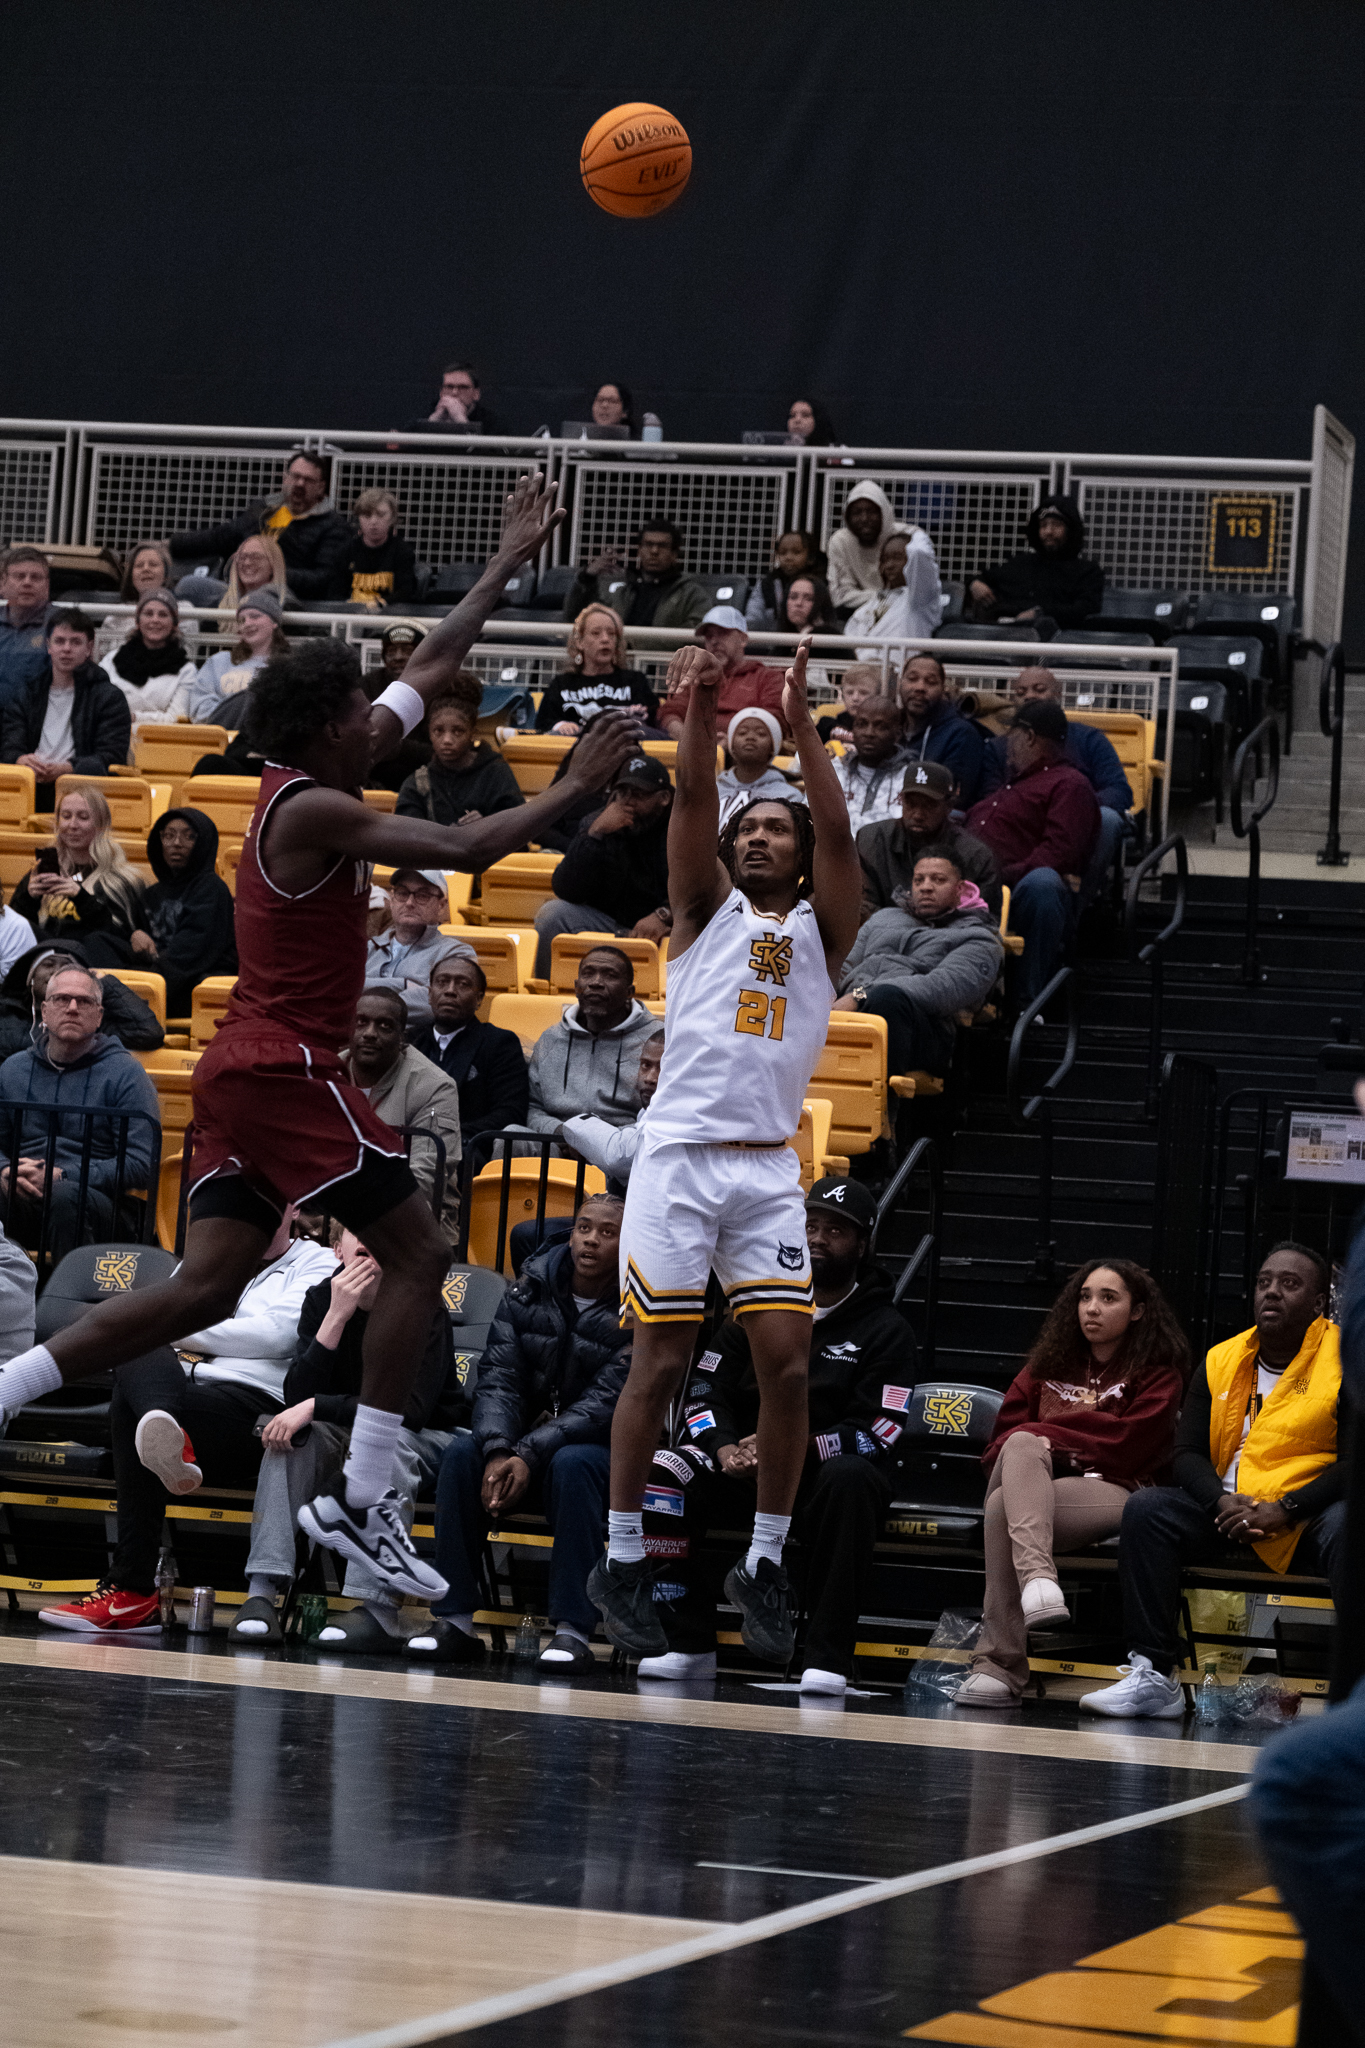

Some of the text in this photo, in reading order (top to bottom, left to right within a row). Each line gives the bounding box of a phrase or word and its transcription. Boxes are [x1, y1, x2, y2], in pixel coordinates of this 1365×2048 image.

[613, 122, 682, 151] Wilson
[1226, 517, 1262, 538] 113
[915, 766, 928, 784] LA
[735, 989, 787, 1041] 21
[822, 1185, 847, 1203] A
[16, 1450, 66, 1465] OWLS
[884, 1520, 938, 1536] OWLS
[28, 1581, 43, 1590] 43
[894, 1647, 909, 1656] 48
[1060, 1662, 1075, 1672] 49
